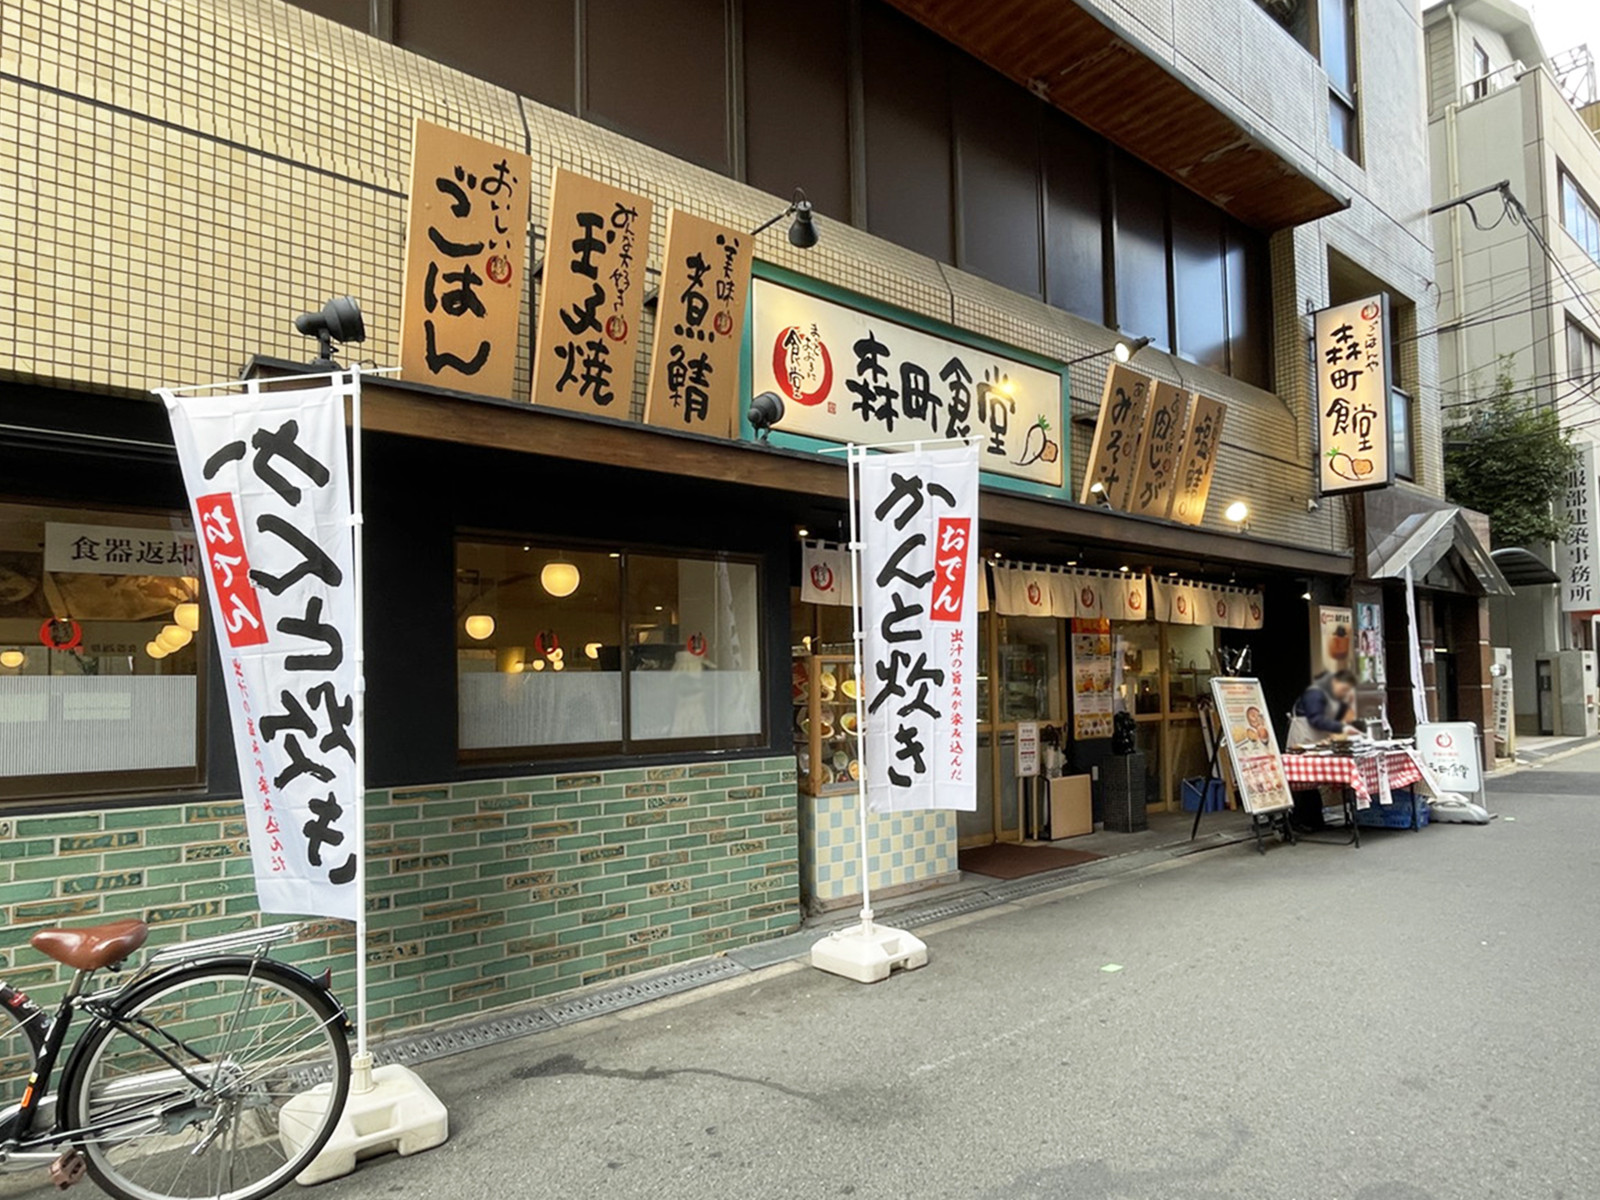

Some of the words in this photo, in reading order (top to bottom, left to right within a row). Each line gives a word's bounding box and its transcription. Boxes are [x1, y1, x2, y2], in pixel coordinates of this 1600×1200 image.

[481, 159, 518, 249] おいしい
[427, 165, 491, 376] ごはん
[555, 212, 616, 406] 玉子焼
[667, 252, 714, 423] 煮鯖
[846, 330, 1016, 456] 森町食堂
[1325, 322, 1378, 452] 森町食堂
[1365, 320, 1379, 372] ごはんや
[1096, 387, 1131, 499] みそ汁
[71, 535, 195, 566] 食器返却
[933, 525, 965, 613] おでん
[868, 472, 957, 788] かんと炊き
[949, 629, 964, 781] 出汁の旨みが染み込んだ
